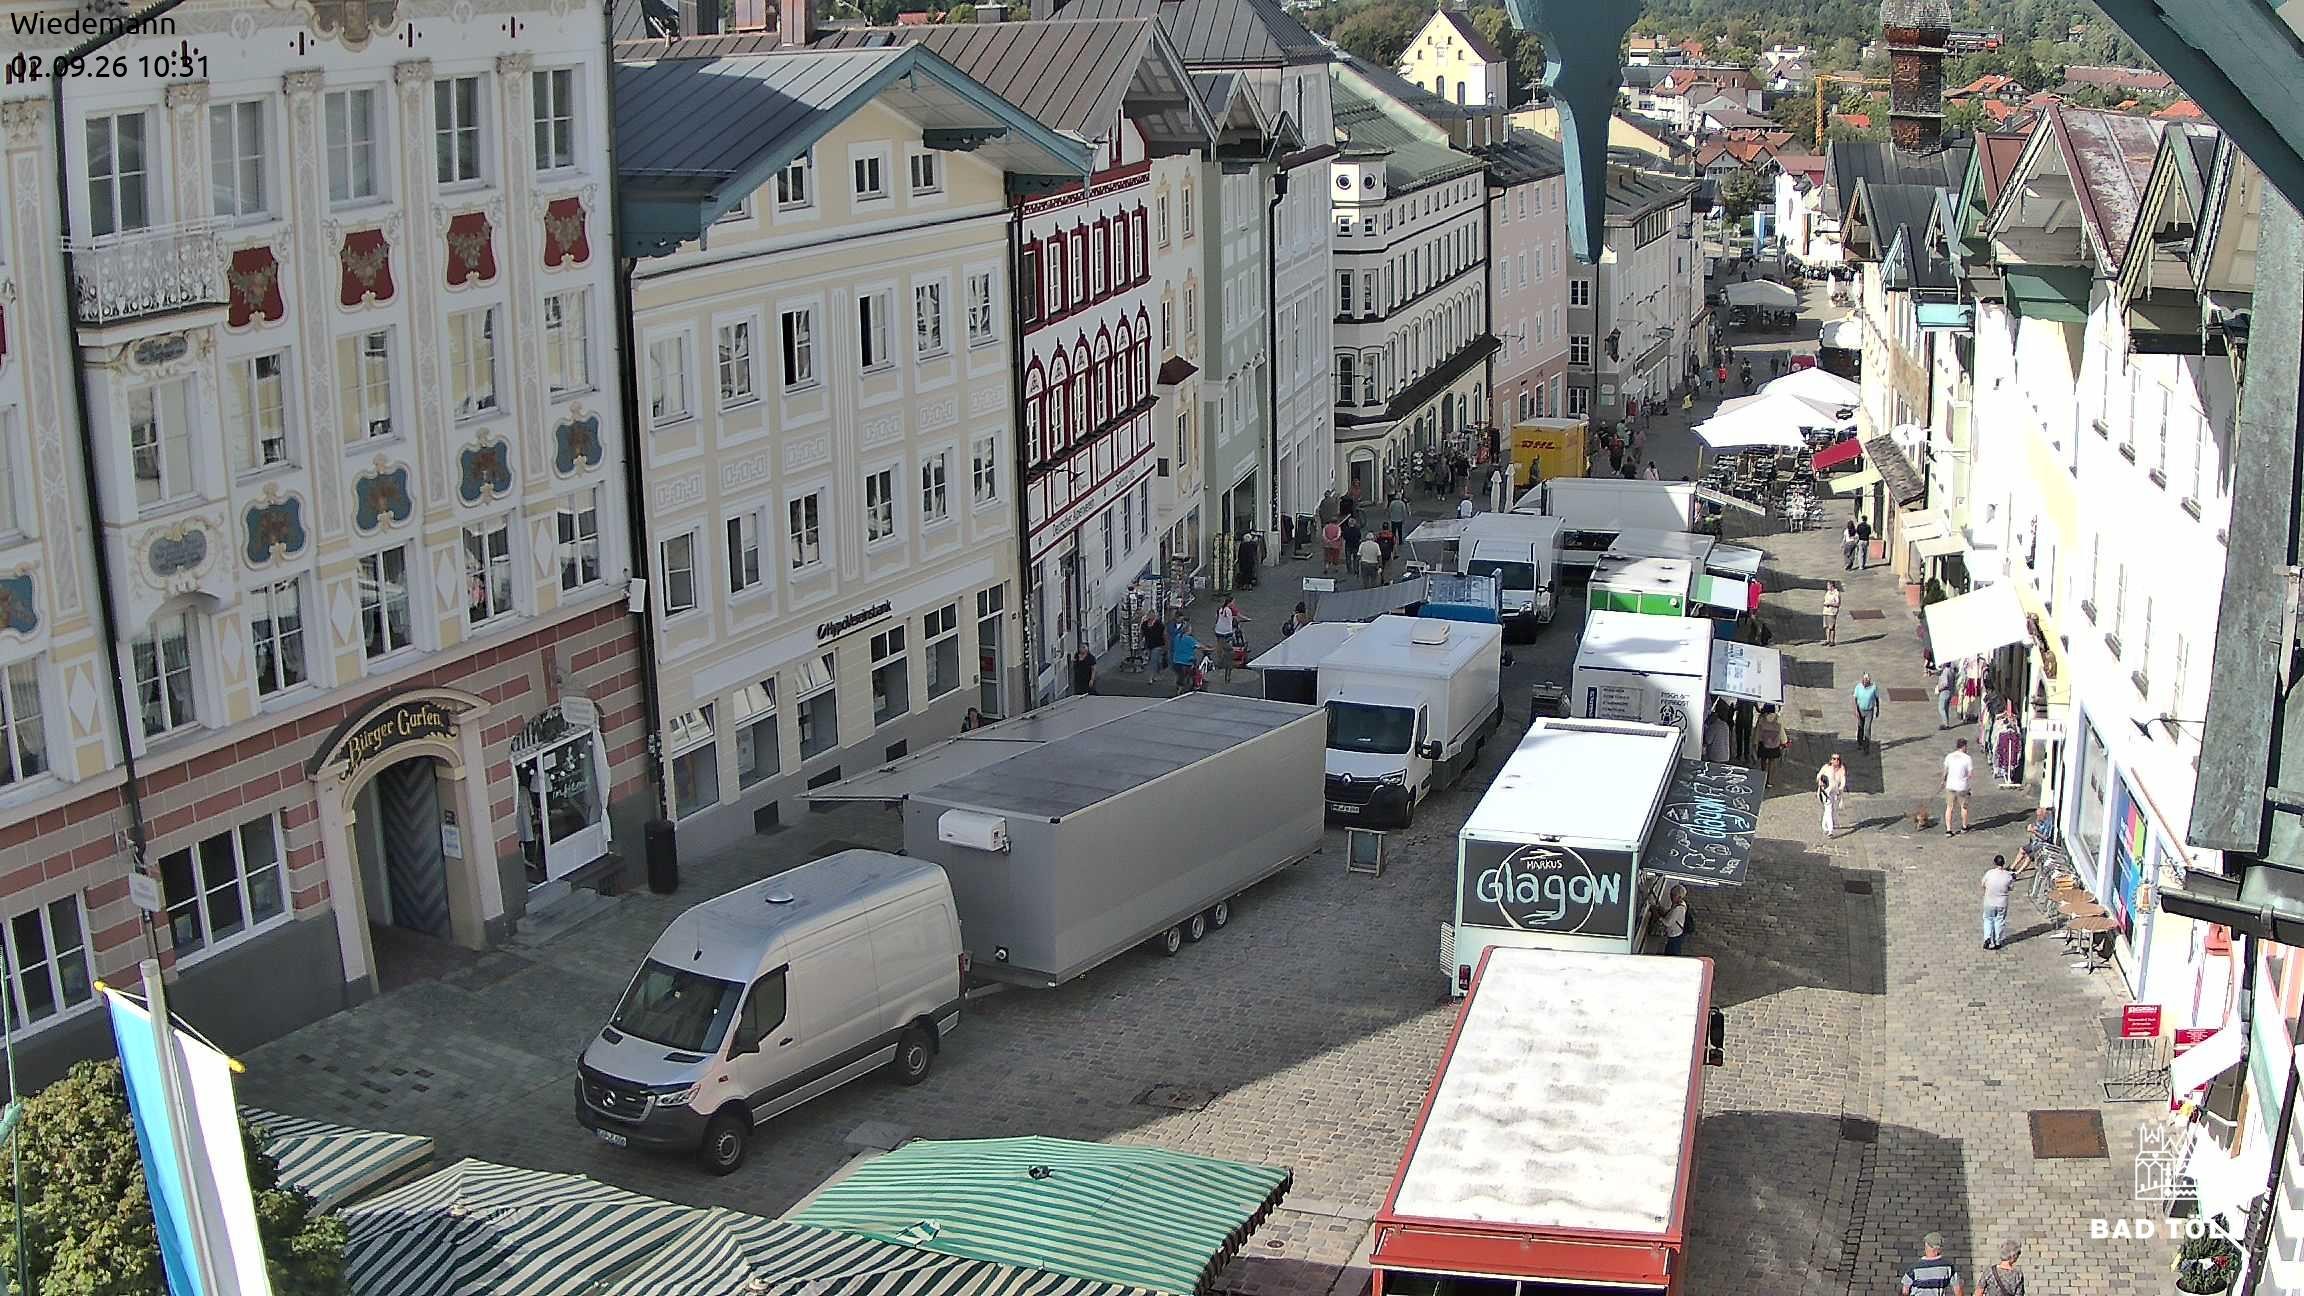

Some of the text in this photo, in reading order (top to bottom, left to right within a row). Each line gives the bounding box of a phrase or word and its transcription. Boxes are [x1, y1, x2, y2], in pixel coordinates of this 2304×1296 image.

[1521, 440, 1555, 449] DHL
[348, 720, 394, 767] Bürger
[1526, 859, 1563, 870] MARKUS
[1476, 863, 1621, 921] Glagow
